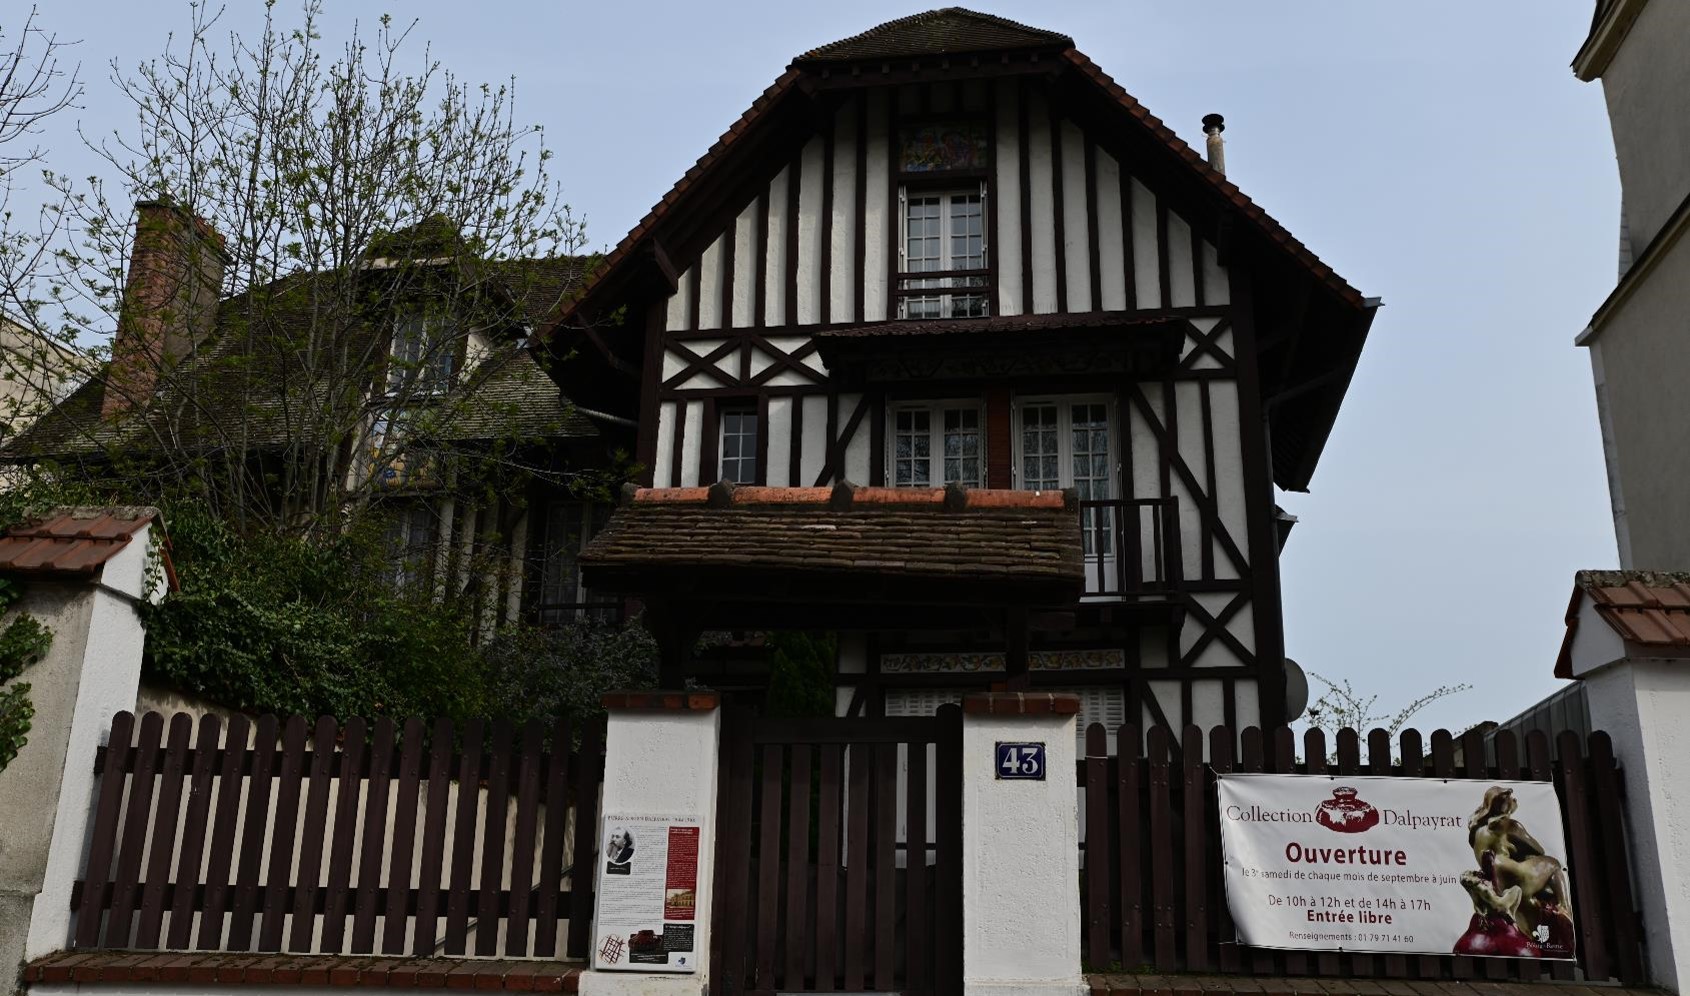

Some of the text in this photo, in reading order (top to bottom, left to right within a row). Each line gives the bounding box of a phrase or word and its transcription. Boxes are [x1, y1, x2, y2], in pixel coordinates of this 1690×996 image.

[1002, 747, 1039, 774] 43
[1226, 805, 1463, 830] Collection Dalpayrat
[1285, 842, 1407, 866] Ouverture
[1242, 867, 1250, 877] le
[1261, 869, 1292, 879] samedi
[1294, 871, 1306, 880] de
[1308, 871, 1341, 882] chaque
[1344, 872, 1365, 881] mois
[1367, 872, 1379, 882] de
[1381, 873, 1430, 884] septembre
[1432, 874, 1437, 884] à
[1439, 874, 1457, 886] juin
[1268, 894, 1431, 911] De 10h à 12h et de 14h à 17h
[1307, 909, 1393, 925] Entrée libre
